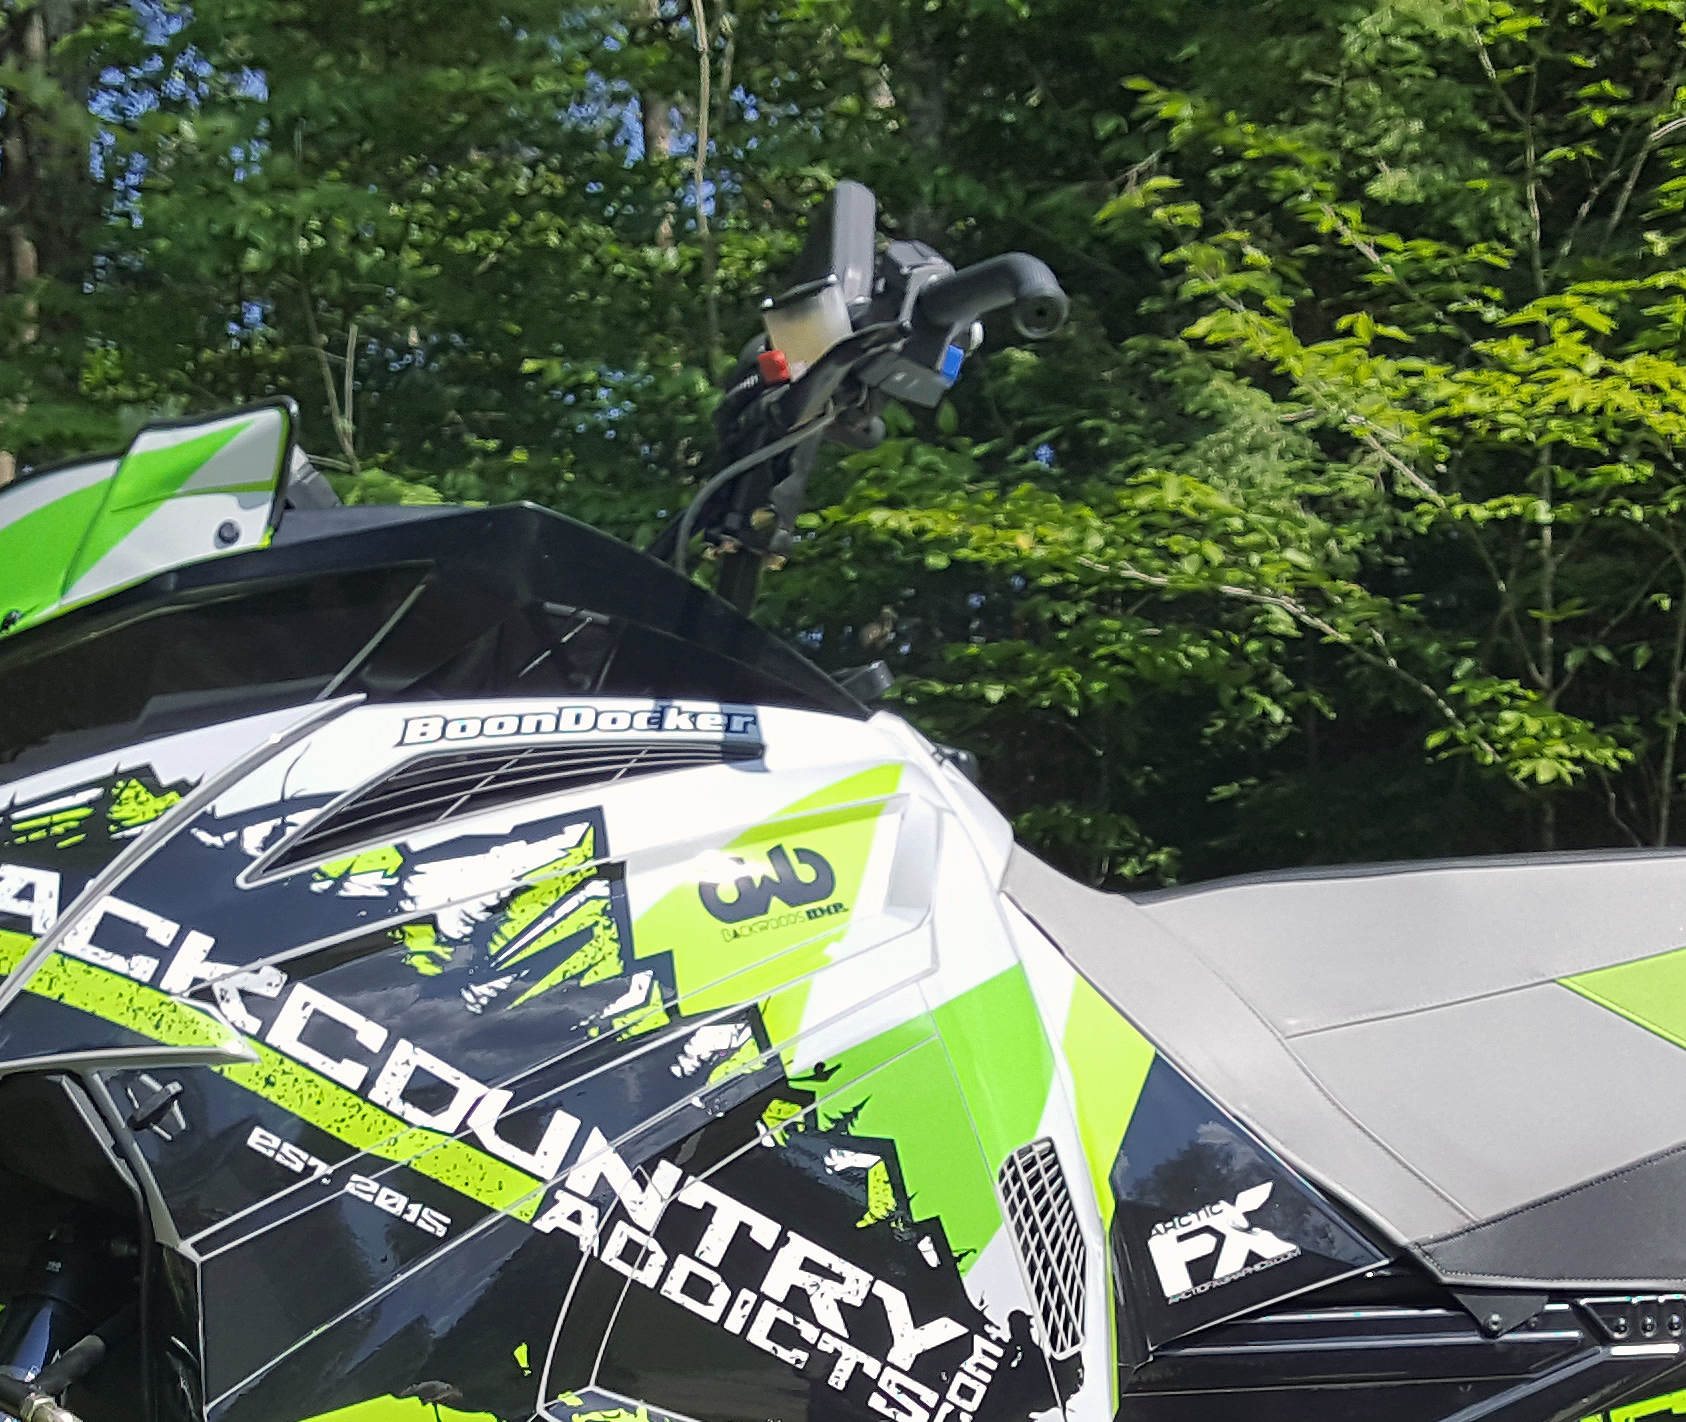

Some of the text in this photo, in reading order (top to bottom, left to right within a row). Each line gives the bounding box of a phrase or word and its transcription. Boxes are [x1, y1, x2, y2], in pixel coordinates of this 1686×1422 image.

[393, 705, 757, 748] BoonDocker
[344, 1172, 453, 1238] 2015
[1147, 1181, 1299, 1298] FX
